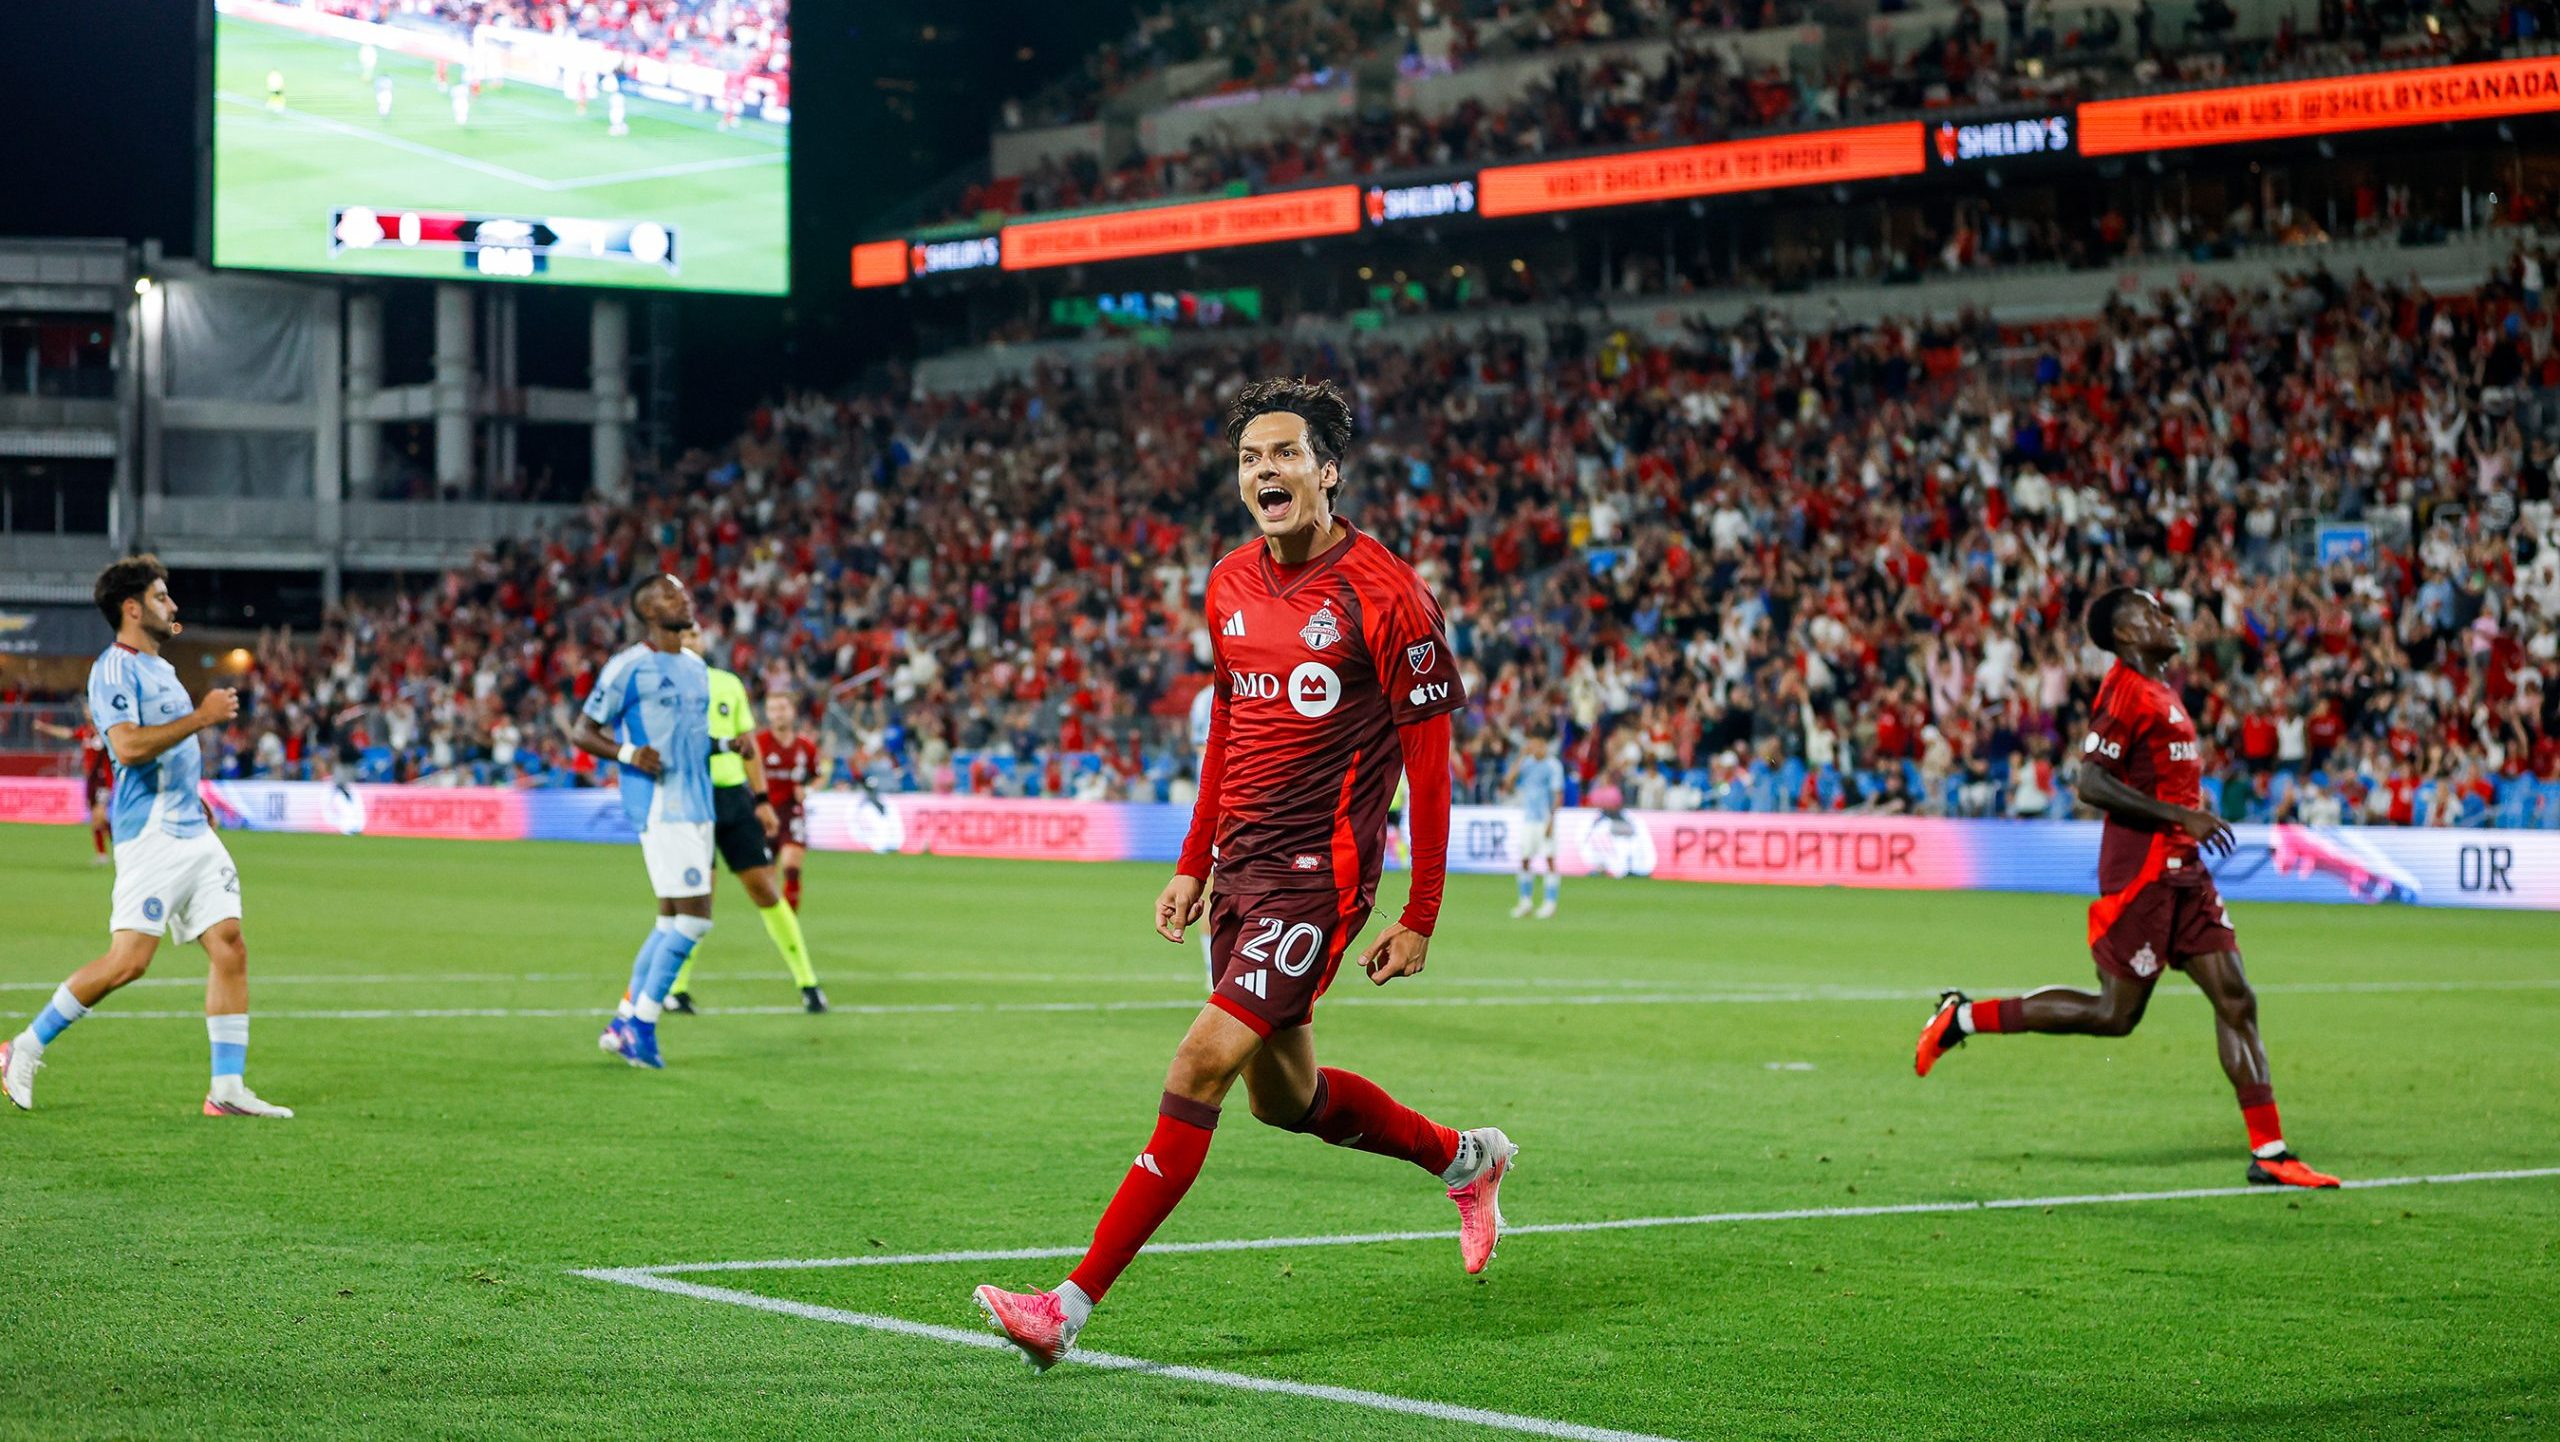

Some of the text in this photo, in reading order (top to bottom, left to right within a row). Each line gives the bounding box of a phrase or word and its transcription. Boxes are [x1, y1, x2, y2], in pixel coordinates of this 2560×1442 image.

[2142, 103, 2241, 134] FOLLOW
[2251, 95, 2292, 123] US!
[1958, 115, 2068, 159] SHELBY'S
[1410, 646, 1425, 656] MLS
[1426, 682, 1448, 701] tv
[2099, 738, 2121, 759] LG
[913, 809, 1089, 848] PREDATOR
[1466, 820, 1507, 861] OR
[1673, 826, 1917, 875] PREDATOR
[2459, 845, 2513, 892] OR
[1240, 917, 1323, 977] 20
